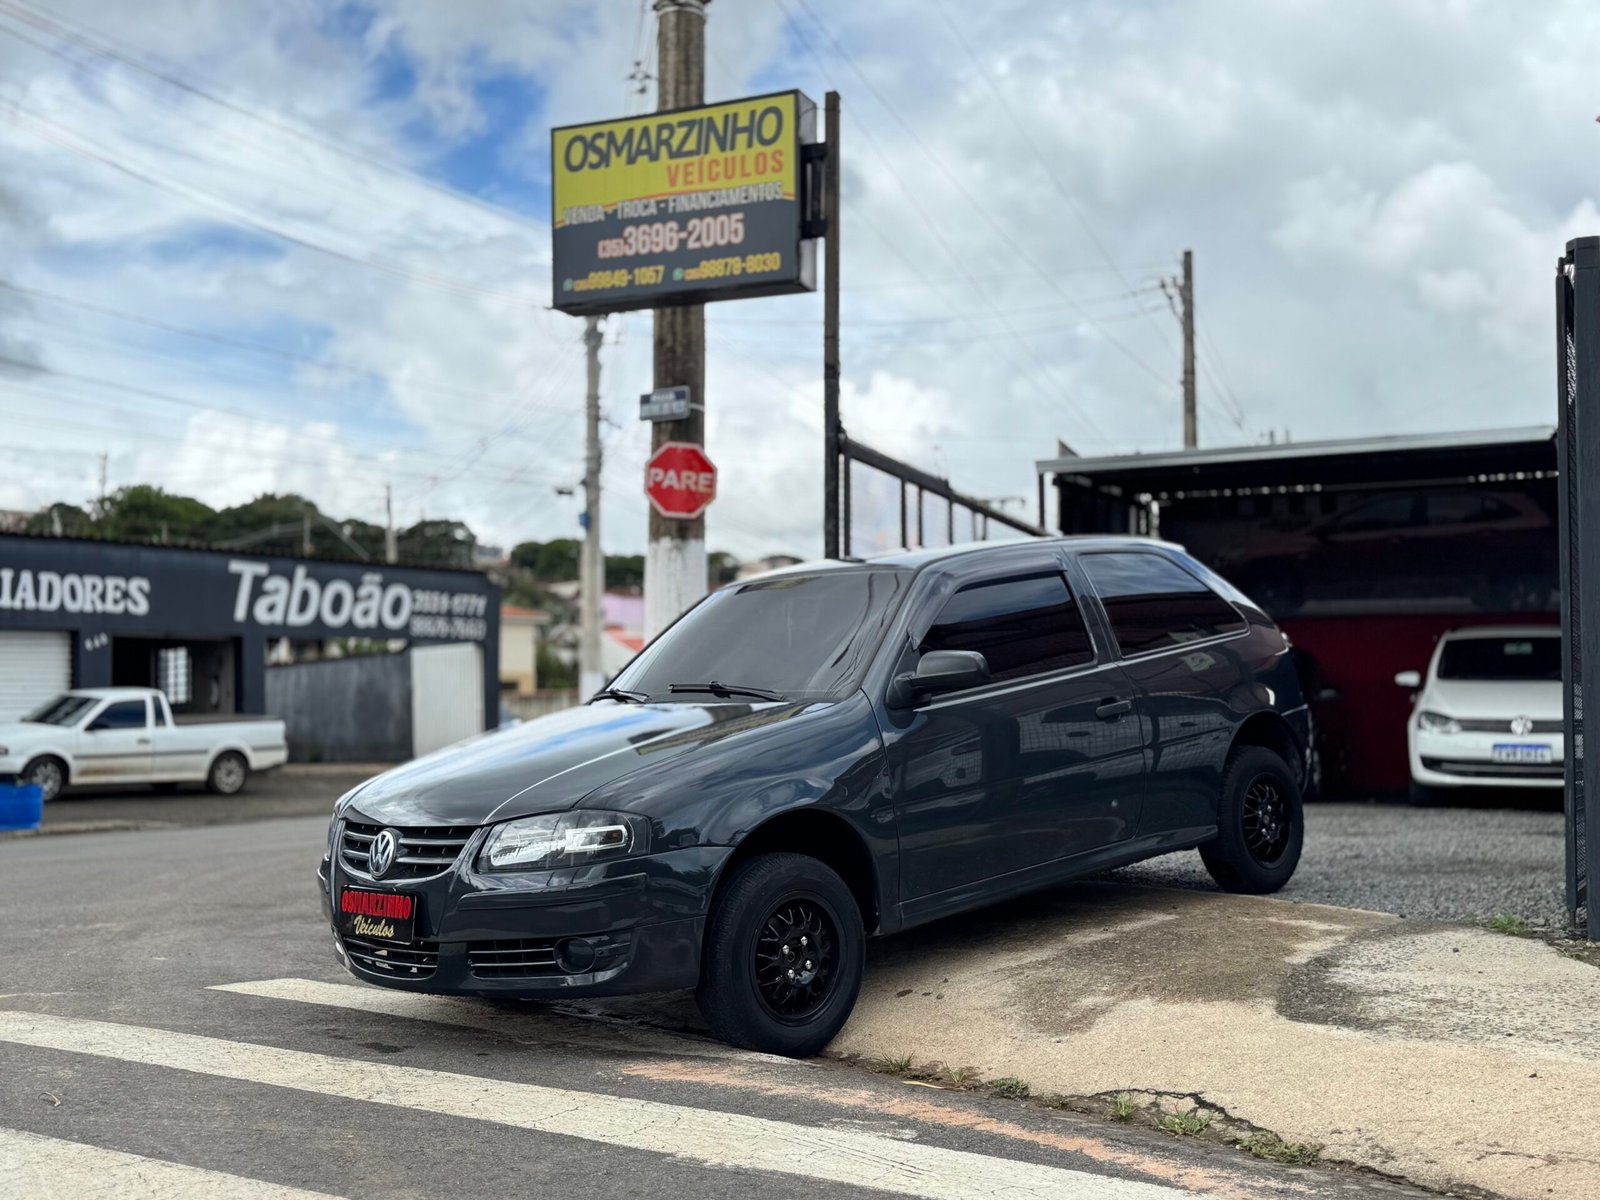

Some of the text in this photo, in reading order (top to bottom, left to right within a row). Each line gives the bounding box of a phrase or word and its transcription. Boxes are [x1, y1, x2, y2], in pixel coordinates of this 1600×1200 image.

[565, 107, 783, 172] OSMARZINHO
[666, 149, 785, 188] VEÍCULOS
[563, 204, 606, 226] VENDA
[617, 198, 658, 220] TROCA
[668, 181, 784, 214] FINANCIAMENTOS
[650, 468, 713, 493] PARE
[229, 560, 411, 629] Taboão
[342, 890, 411, 919] OSMARZINHO
